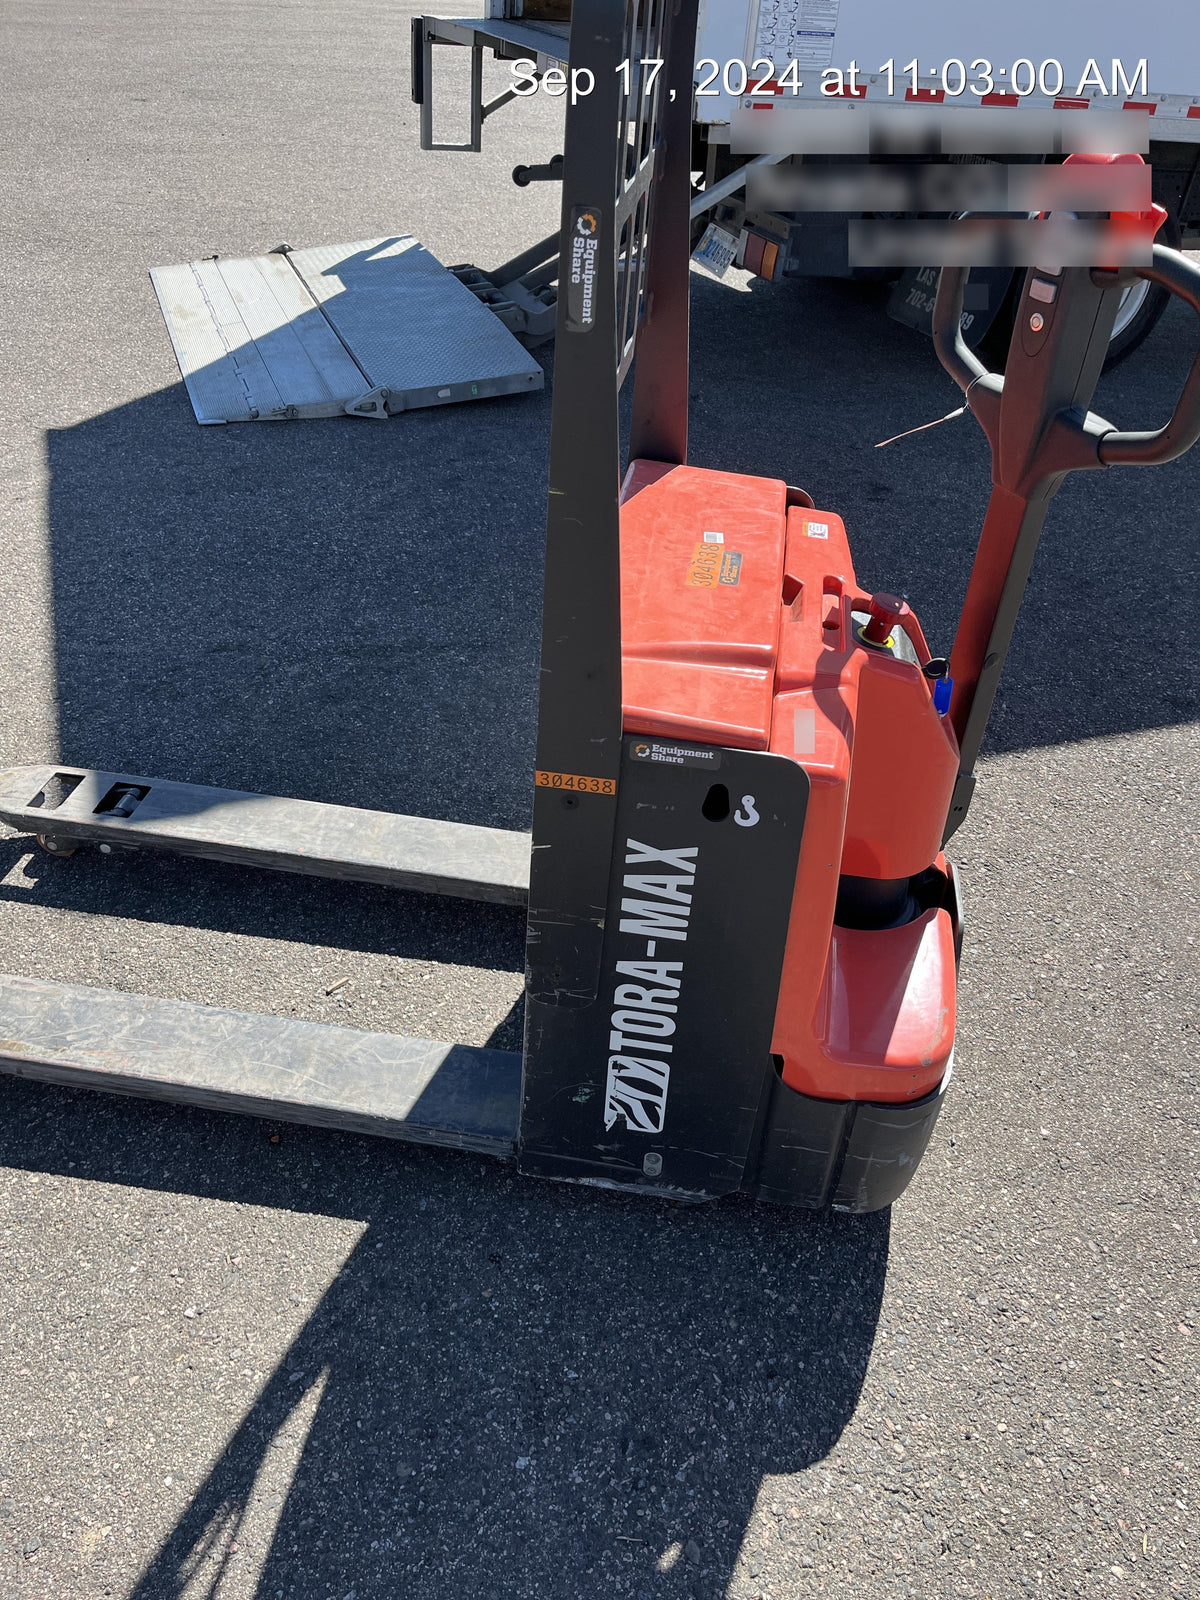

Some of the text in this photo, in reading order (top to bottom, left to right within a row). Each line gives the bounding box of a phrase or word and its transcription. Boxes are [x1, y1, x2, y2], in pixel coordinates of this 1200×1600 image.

[571, 236, 585, 284] Share
[915, 265, 937, 287] LAS
[582, 238, 598, 324] Equipment
[691, 543, 720, 587] 304638
[650, 752, 685, 764] Share
[651, 743, 715, 760] Equipment
[540, 772, 613, 794] 304638
[608, 837, 699, 1054] TORA-MAX
